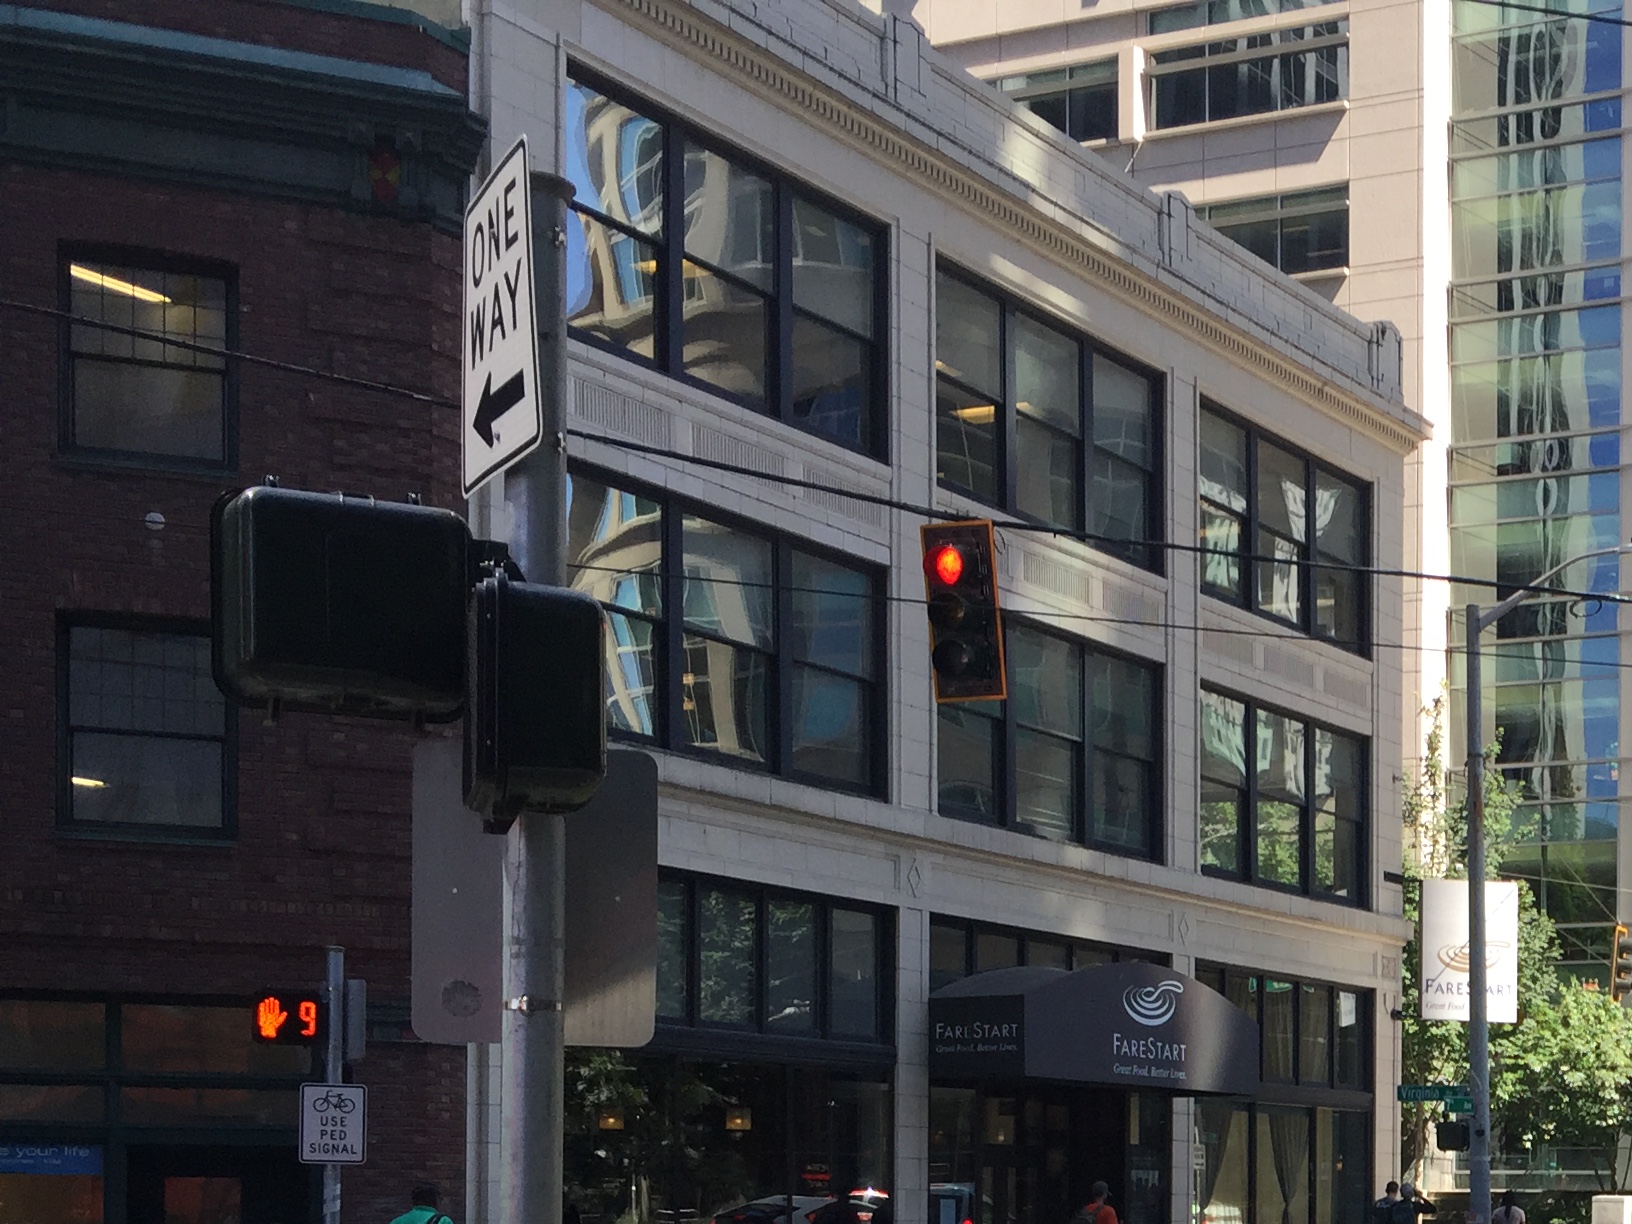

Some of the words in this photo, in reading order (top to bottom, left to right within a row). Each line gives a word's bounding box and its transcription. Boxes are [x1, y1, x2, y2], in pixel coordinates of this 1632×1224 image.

[472, 177, 519, 288] ONE
[470, 258, 522, 370] WAY
[300, 1001, 317, 1037] 9
[1401, 1086, 1440, 1100] Virginia
[320, 1116, 347, 1127] USE
[320, 1130, 347, 1140] PED
[16, 1147, 58, 1157] your
[64, 1146, 90, 1156] life
[309, 1143, 357, 1155] SIGNAL
